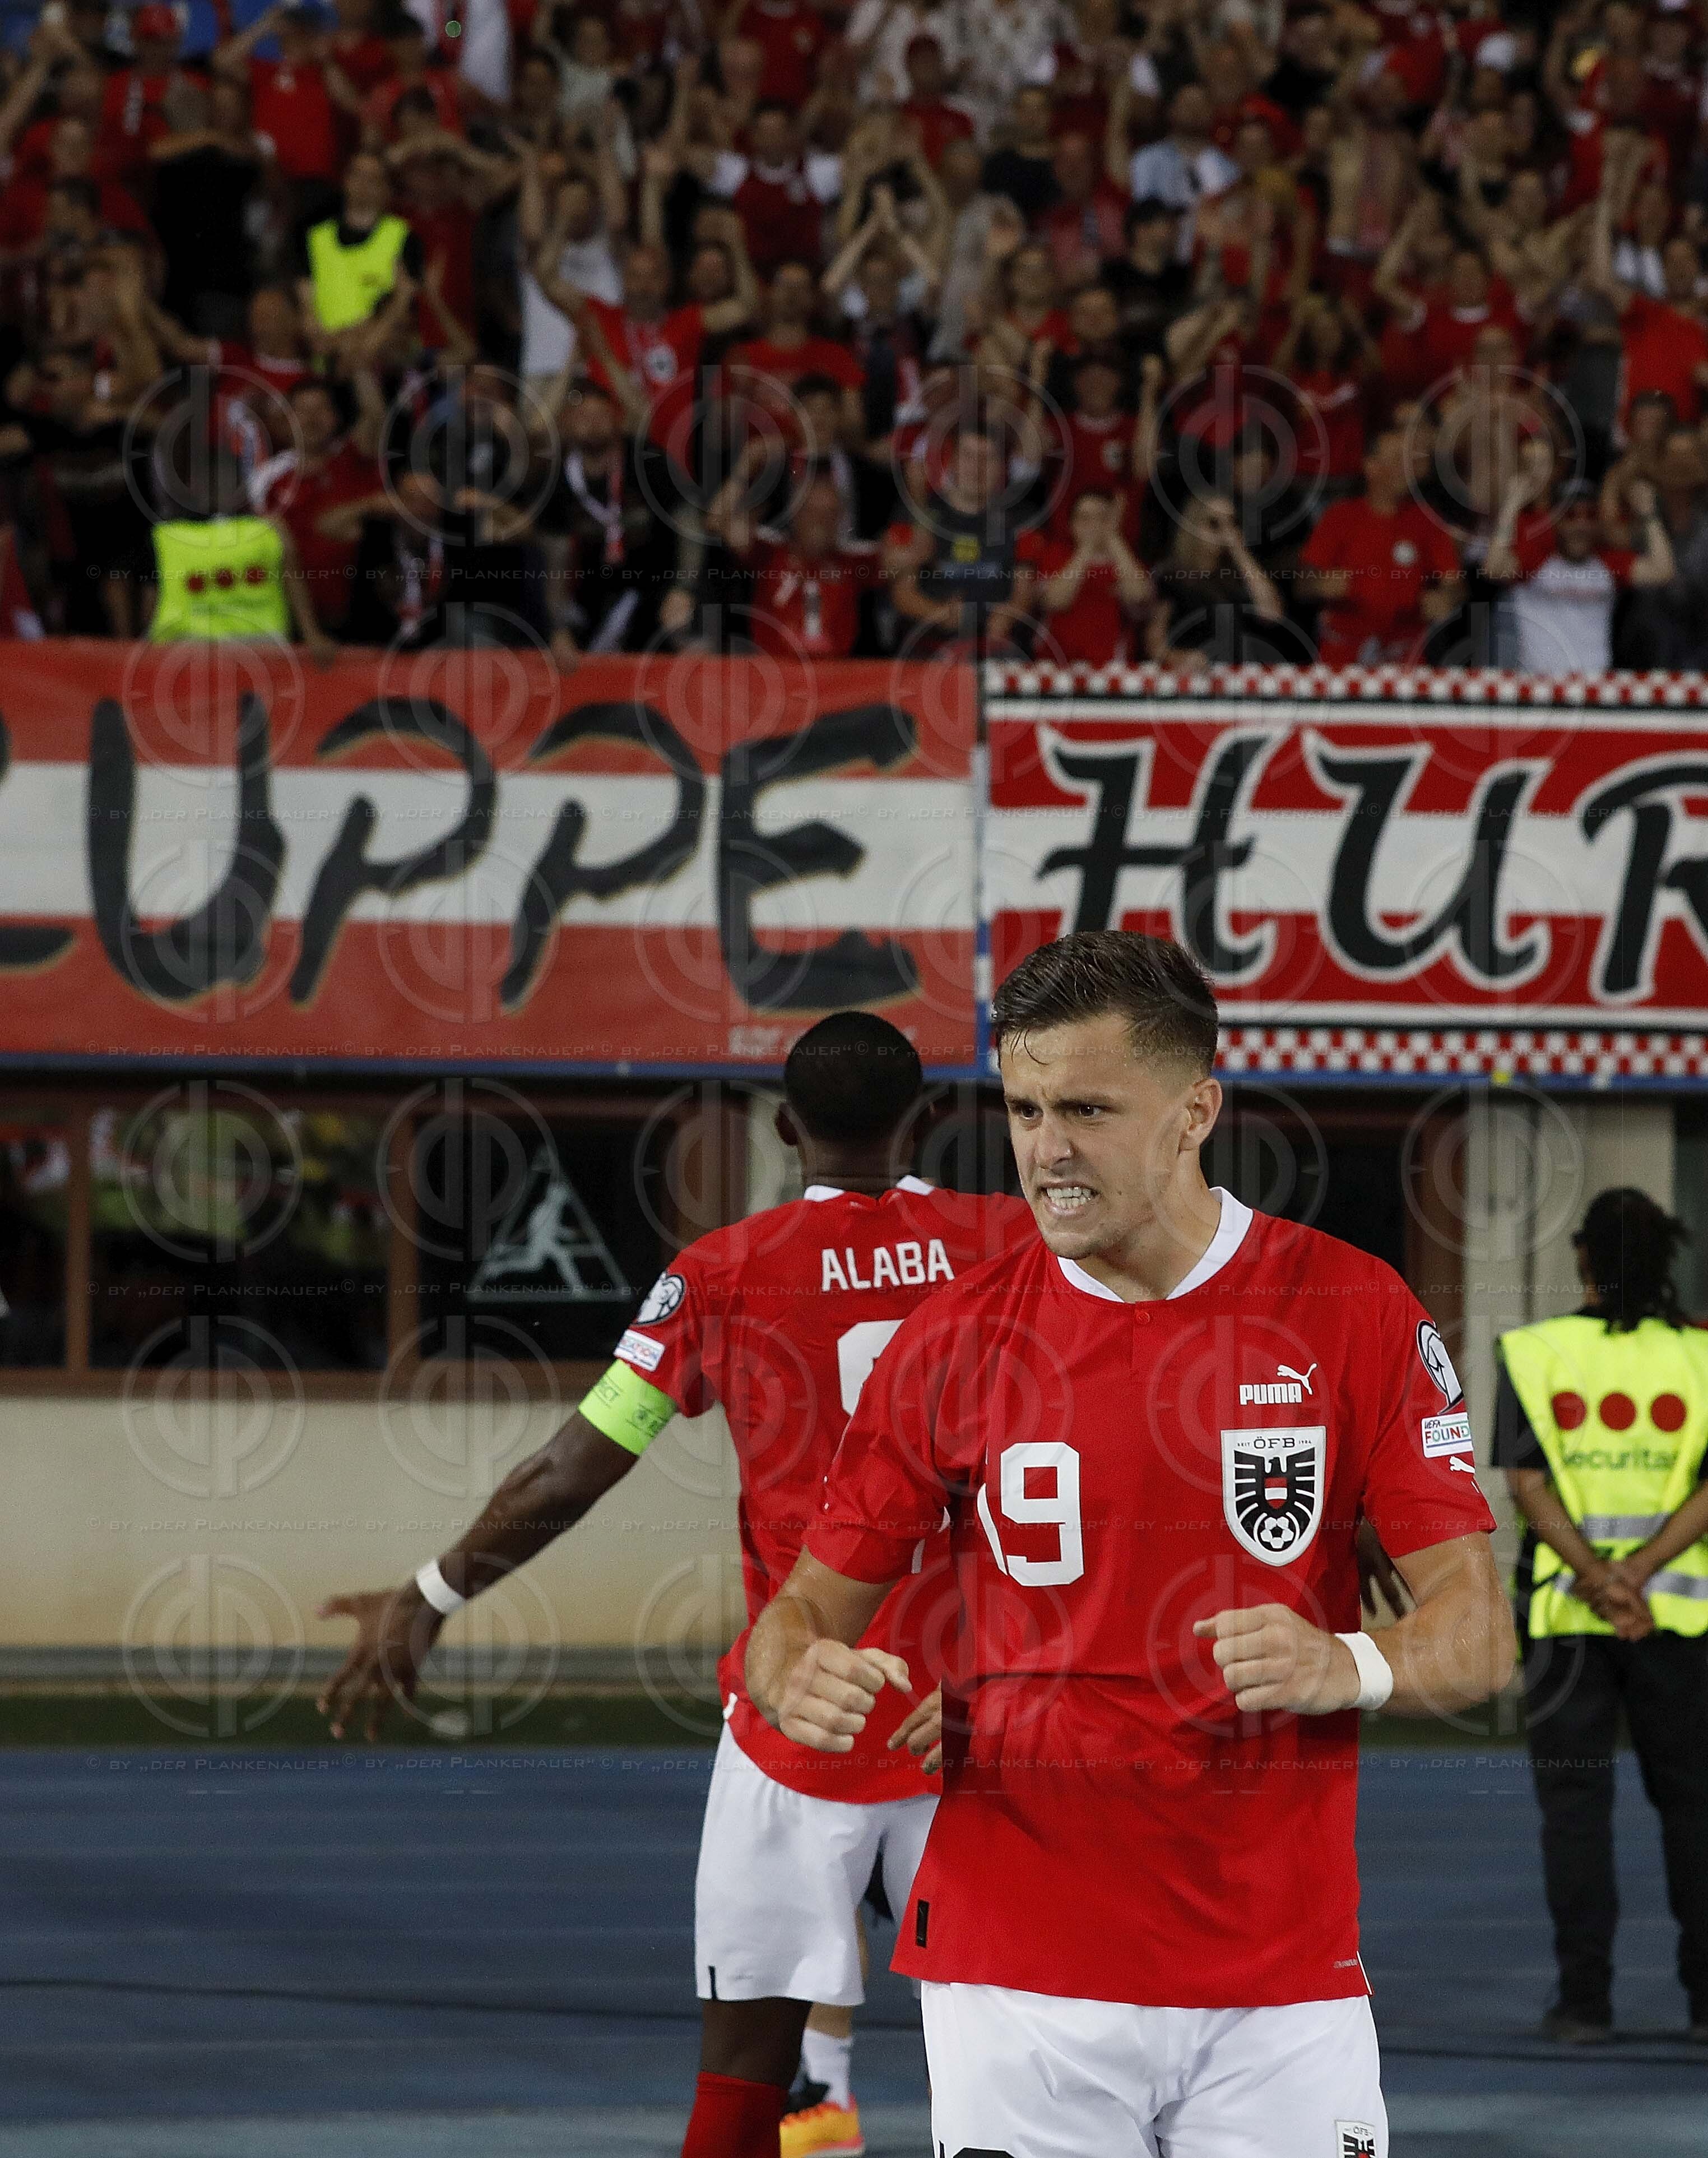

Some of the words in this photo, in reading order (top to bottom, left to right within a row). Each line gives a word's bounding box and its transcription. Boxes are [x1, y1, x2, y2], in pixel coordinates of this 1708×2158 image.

[820, 1239, 955, 1291] ALABA
[1240, 1382, 1302, 1405] PUMA
[1424, 1420, 1441, 1429] UEFA
[1254, 1436, 1295, 1449] ÖFB
[1424, 1426, 1470, 1444] FOUND
